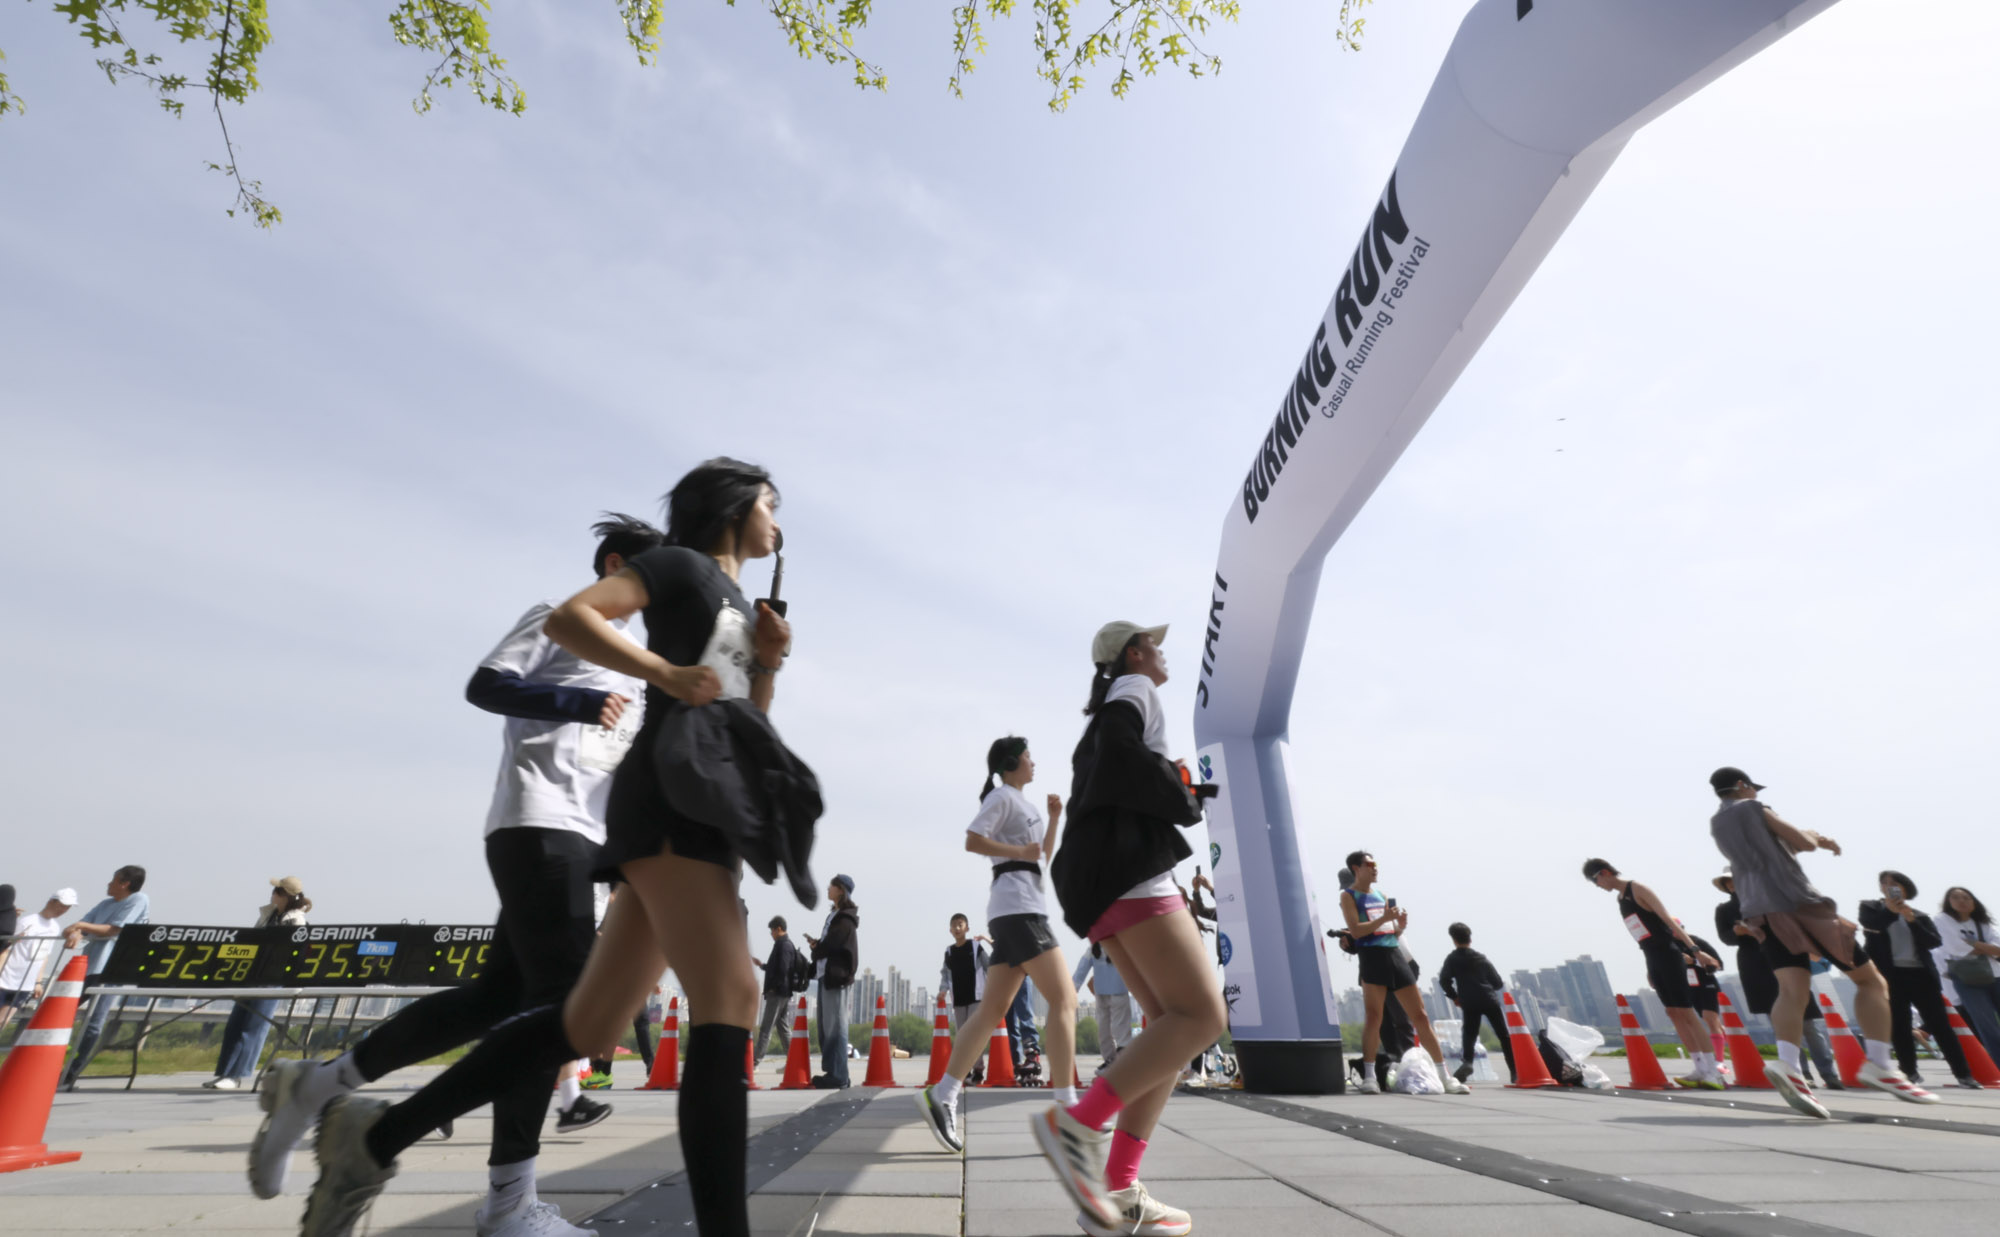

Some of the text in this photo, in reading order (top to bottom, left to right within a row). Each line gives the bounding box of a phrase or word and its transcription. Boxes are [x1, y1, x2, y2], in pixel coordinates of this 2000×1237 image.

[1321, 235, 1431, 419] Casual Running Festival
[1243, 166, 1410, 525] BURNING RUN
[167, 927, 238, 943] SAMIK
[309, 926, 378, 941] SAMIK
[226, 946, 250, 957] 5km
[365, 942, 389, 954] 7km
